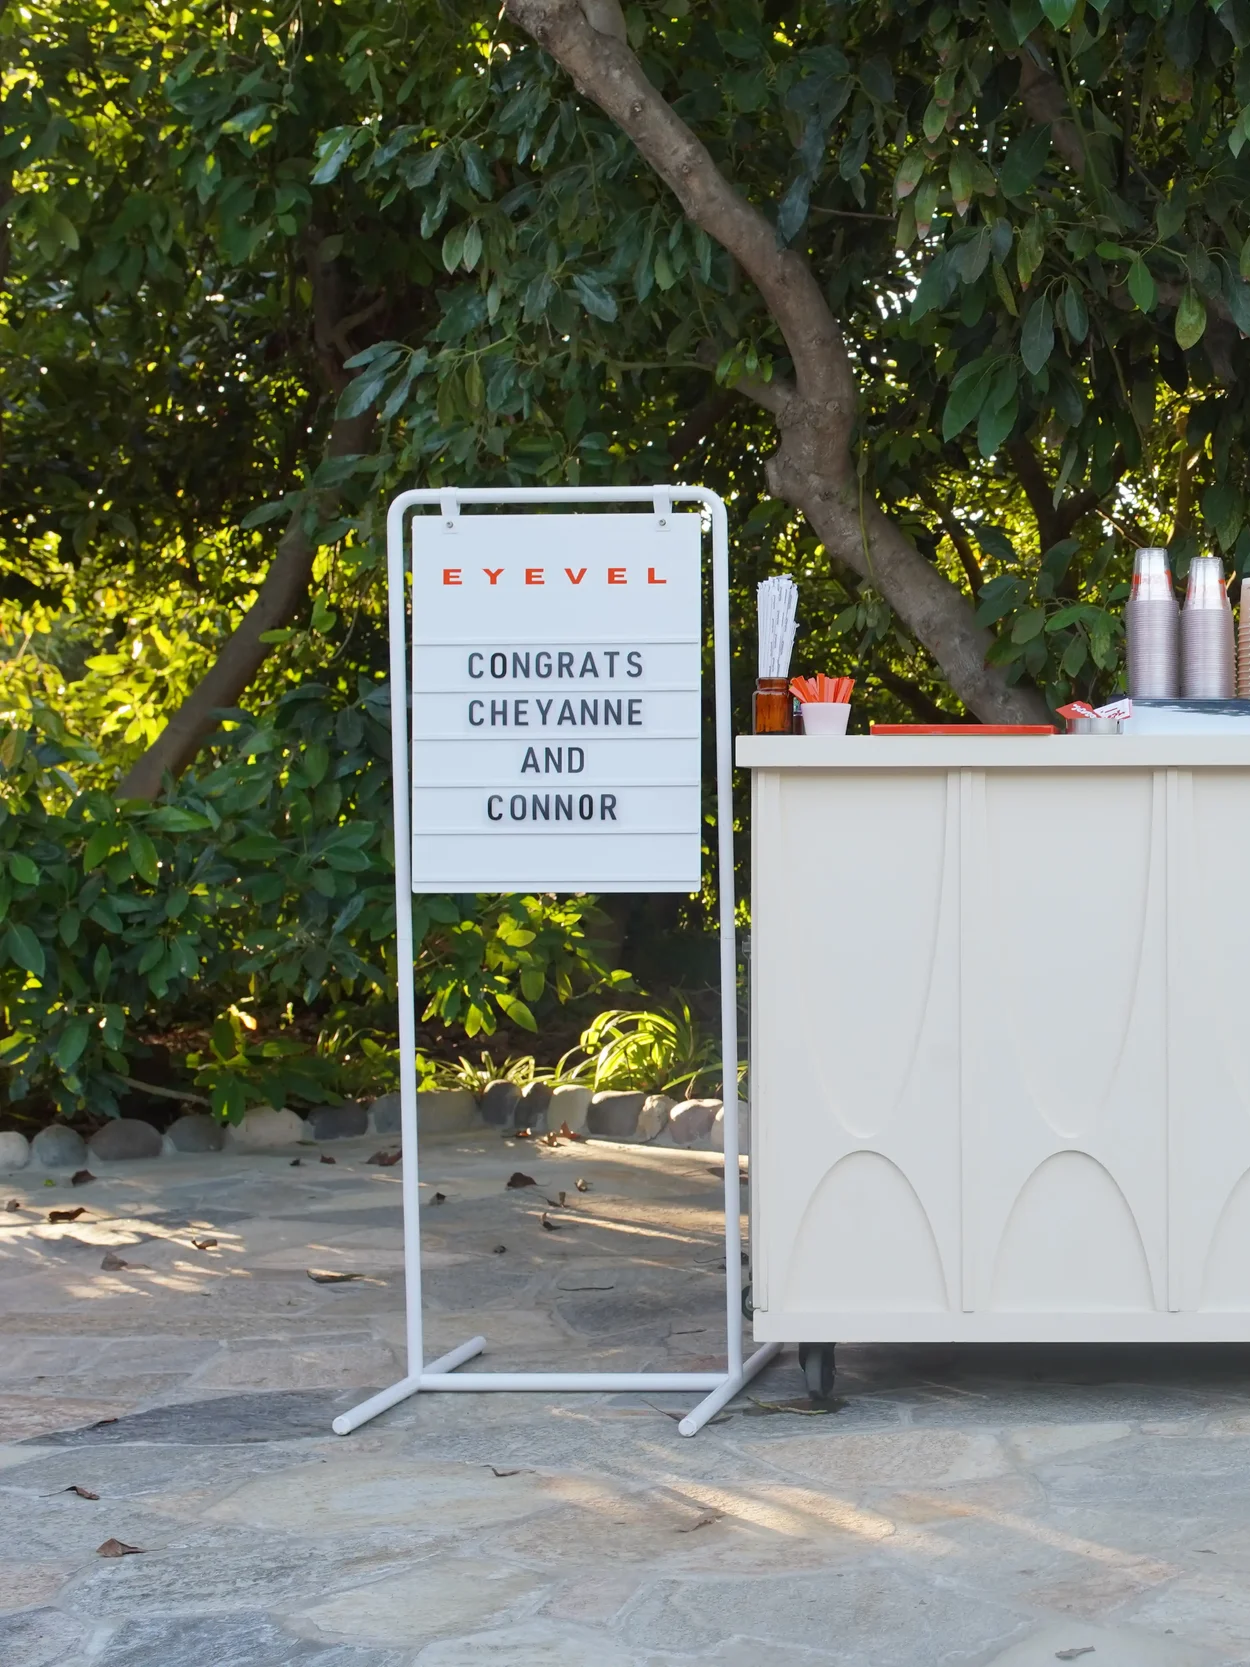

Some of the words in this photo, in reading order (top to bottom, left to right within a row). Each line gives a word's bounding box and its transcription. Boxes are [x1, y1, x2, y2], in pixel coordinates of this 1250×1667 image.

[443, 568, 667, 585] EYEVEL
[468, 652, 643, 678] CONGRATS
[468, 699, 643, 727] CHEYANNE
[521, 746, 585, 774] AND
[487, 794, 617, 822] CONNOR
